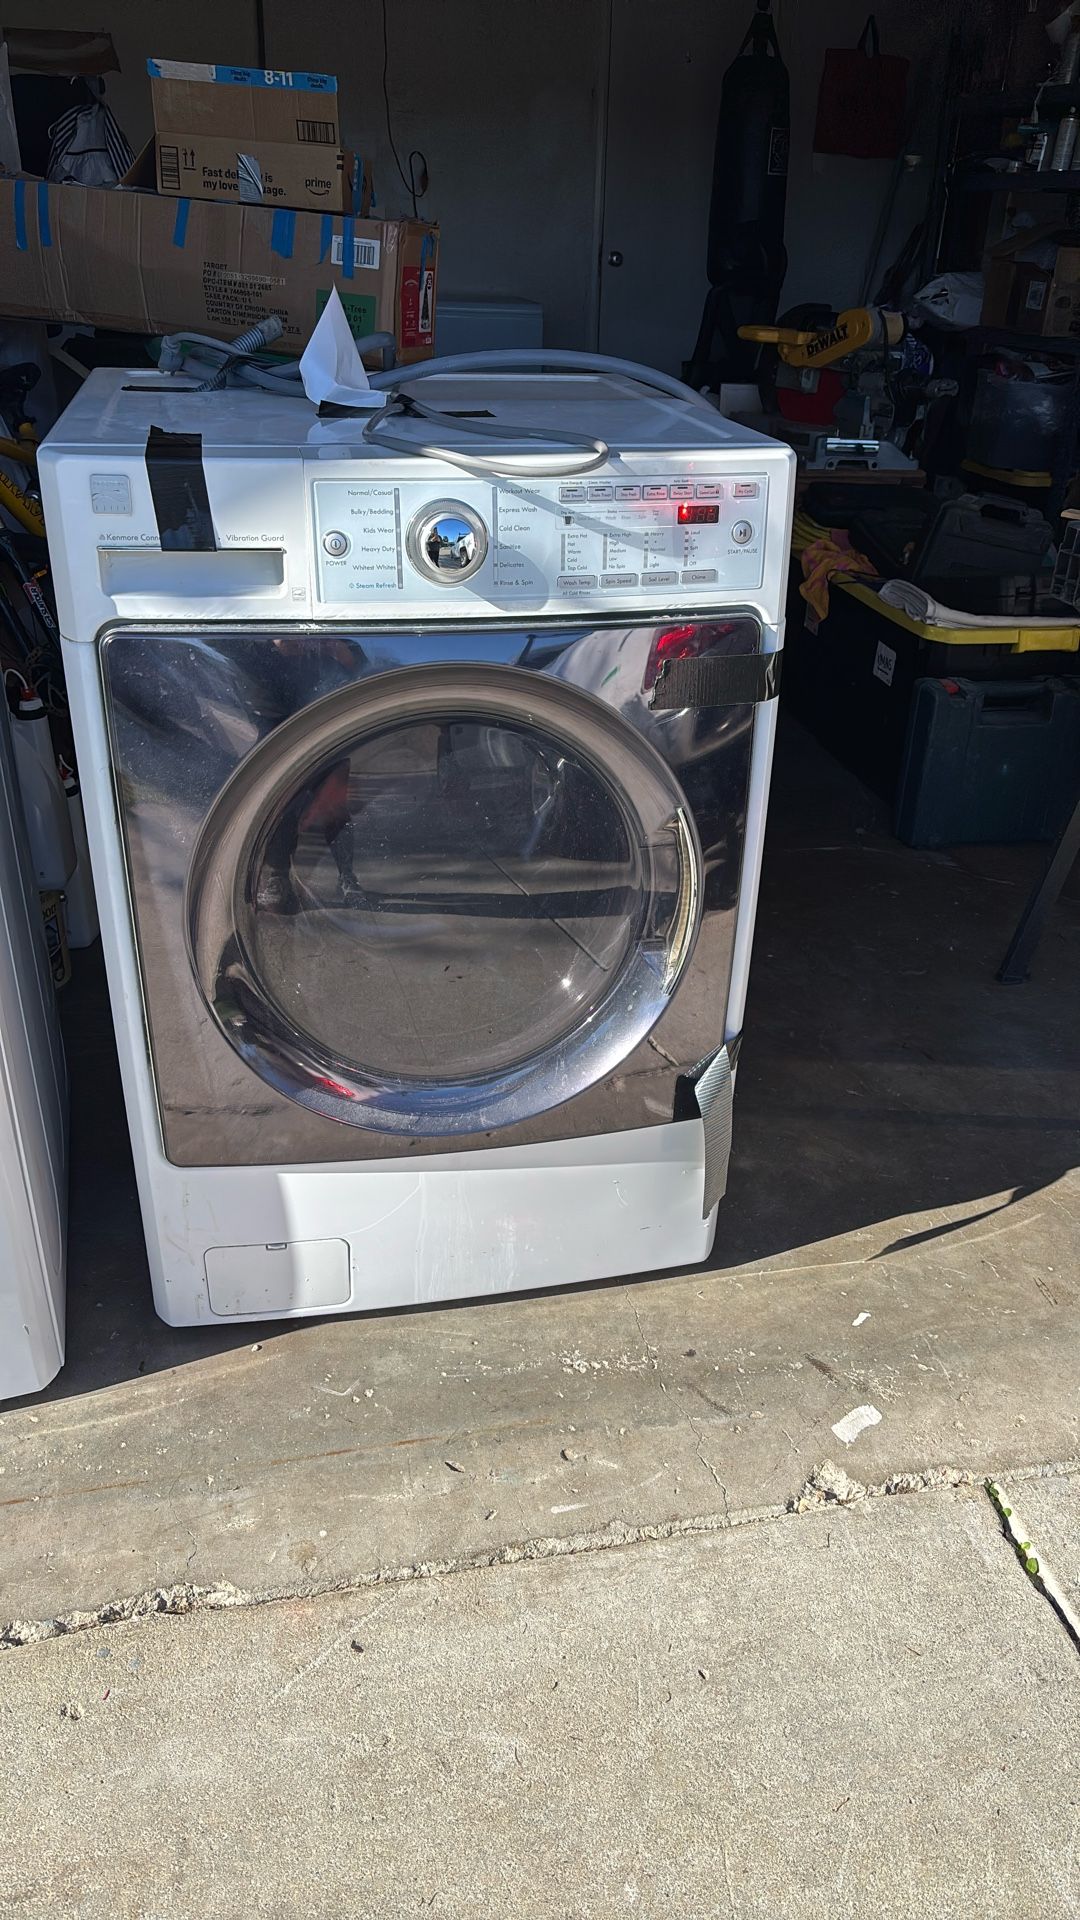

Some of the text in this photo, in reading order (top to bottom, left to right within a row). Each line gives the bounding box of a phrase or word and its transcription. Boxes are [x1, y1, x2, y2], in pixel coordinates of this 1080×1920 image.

[202, 167, 223, 178] Fast
[265, 172, 273, 182] is
[203, 180, 217, 190] my
[219, 180, 238, 190] love
[305, 177, 332, 188] prime
[203, 262, 228, 270] TARGET
[204, 292, 221, 300] CASE
[206, 300, 234, 309] COUNTRY
[206, 308, 231, 316] CARTON
[348, 488, 393, 496] Normal/Casual
[351, 508, 394, 516] Bulky/Bedding
[106, 533, 160, 541] Kenmore Conn
[226, 534, 284, 542] Vibration Guard
[727, 548, 758, 556] START/PAUSE
